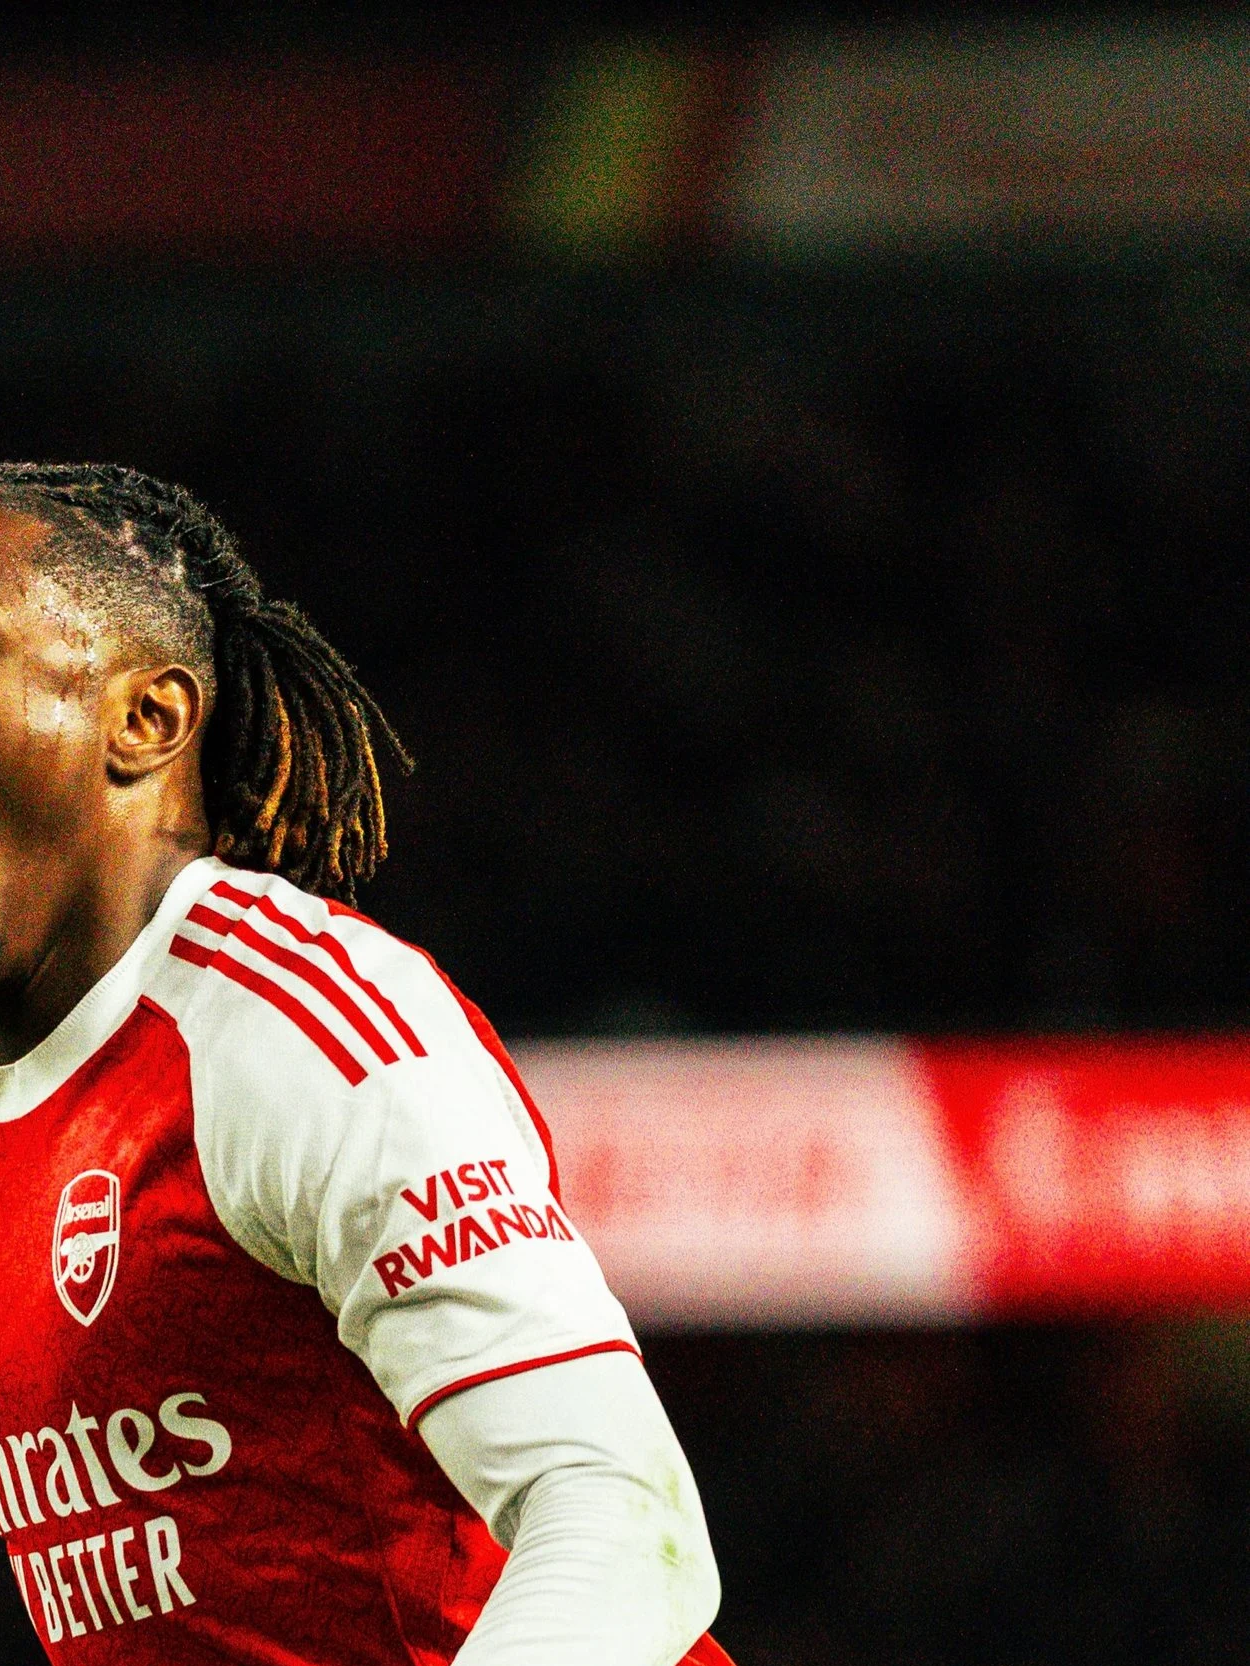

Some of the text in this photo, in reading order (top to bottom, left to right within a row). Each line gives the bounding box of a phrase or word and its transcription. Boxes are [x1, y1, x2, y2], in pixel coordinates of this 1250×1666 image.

[400, 1159, 515, 1223] VISIT
[372, 1203, 575, 1299] RWANDA
[27, 1514, 198, 1644] BETTER
